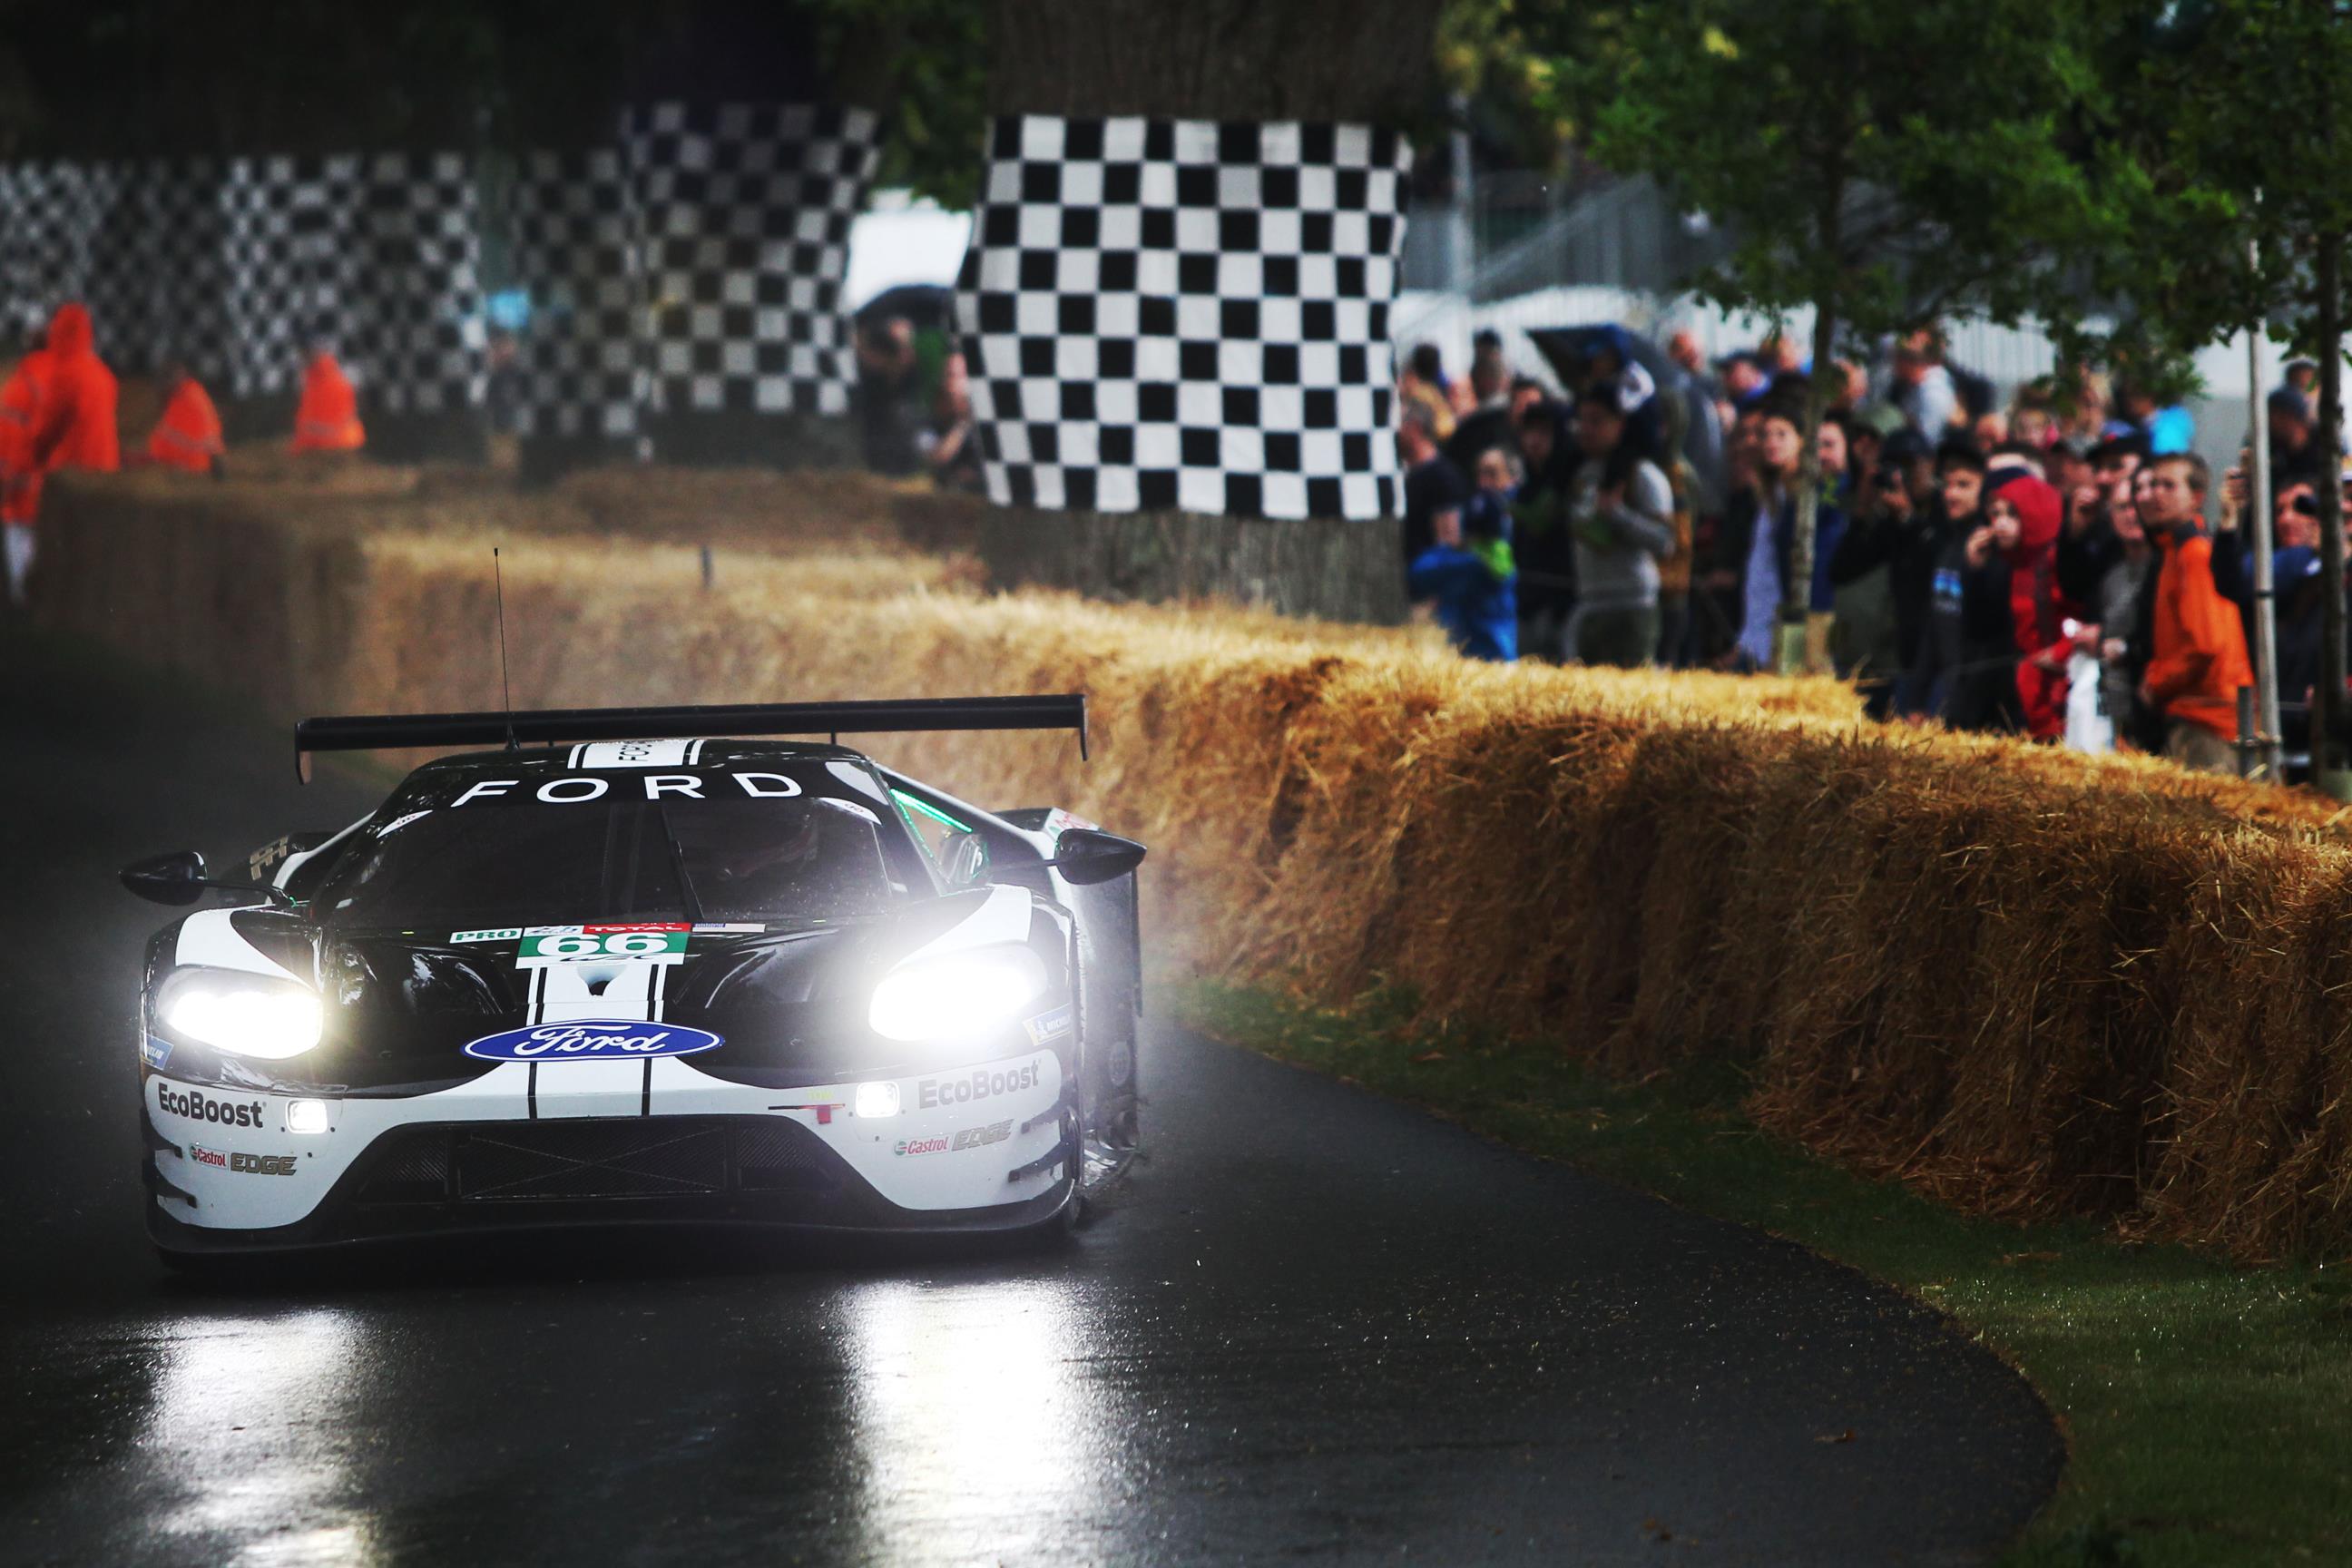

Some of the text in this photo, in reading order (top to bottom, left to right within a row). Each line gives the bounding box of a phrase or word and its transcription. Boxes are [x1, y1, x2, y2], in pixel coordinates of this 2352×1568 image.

[450, 773, 802, 807] FORD
[456, 930, 517, 941] PRO
[537, 932, 669, 957] 66
[514, 1025, 671, 1055] Ford
[918, 1060, 1039, 1109] EcoBoost
[158, 1083, 263, 1128] EcoBoost
[907, 1119, 1014, 1154] Castrol EDGE
[197, 1148, 298, 1176] Castrol EDGE
